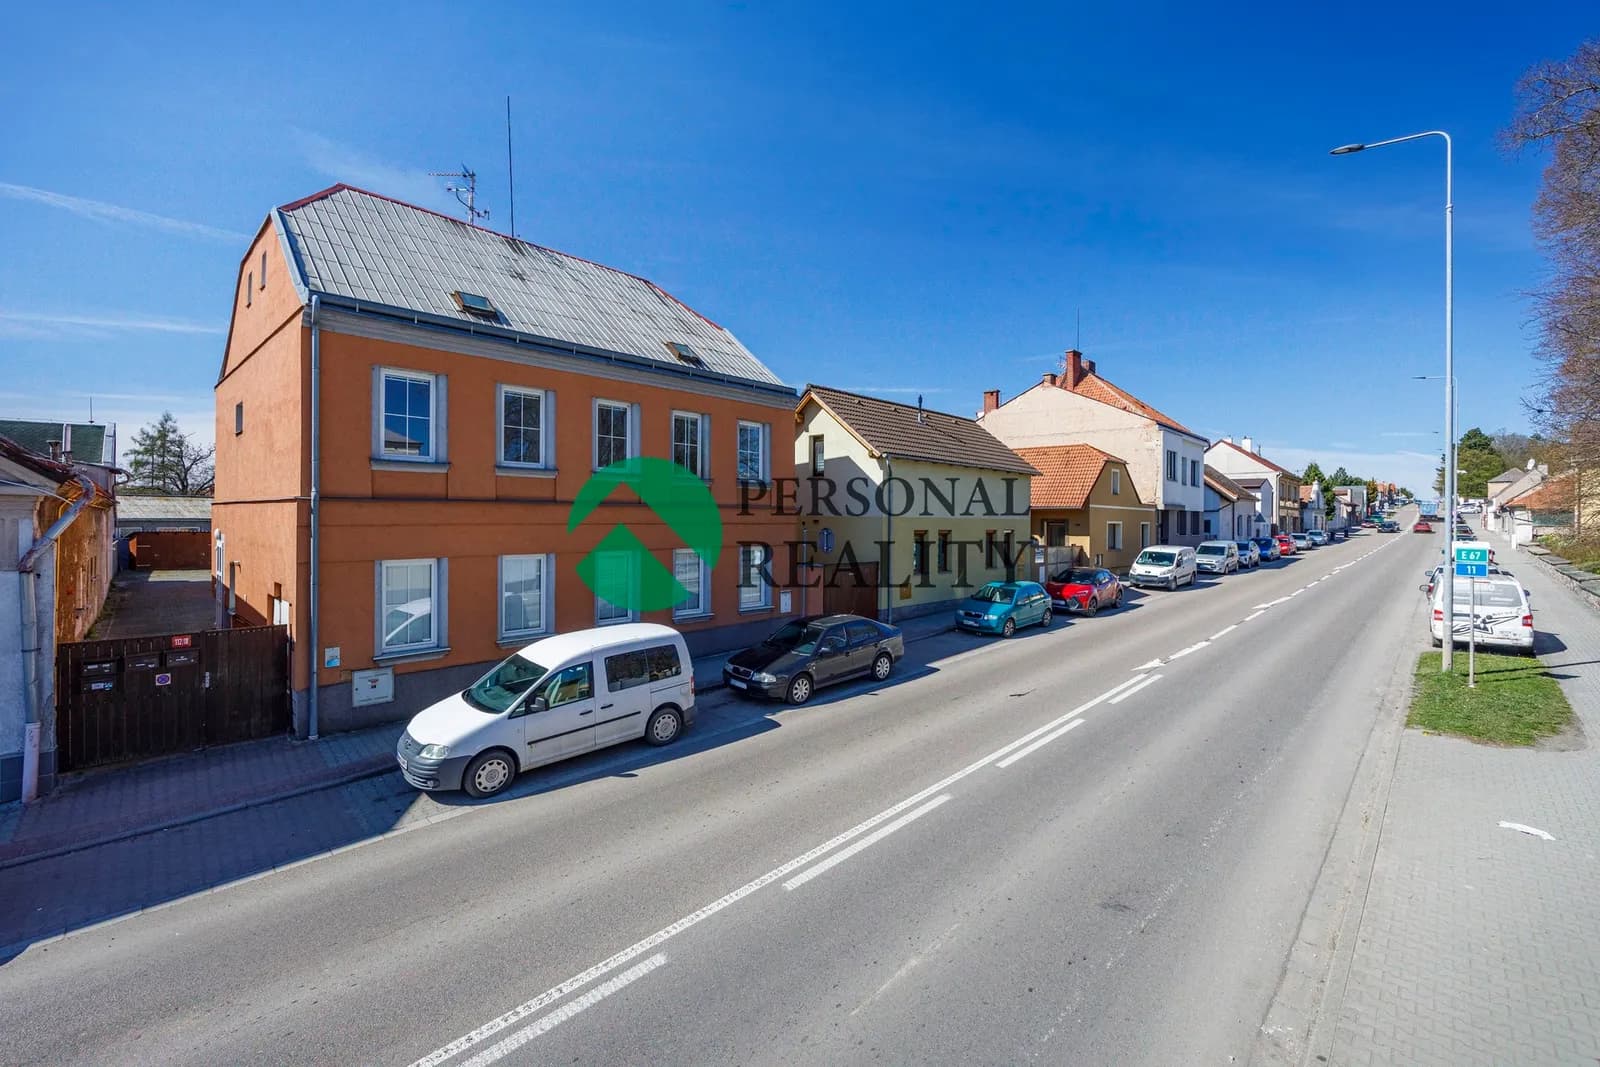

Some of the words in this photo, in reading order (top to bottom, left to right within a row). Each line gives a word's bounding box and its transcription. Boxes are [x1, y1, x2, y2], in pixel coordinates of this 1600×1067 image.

[1461, 551, 1467, 560] E
[1469, 551, 1481, 560] 67
[1466, 565, 1476, 574] 11
